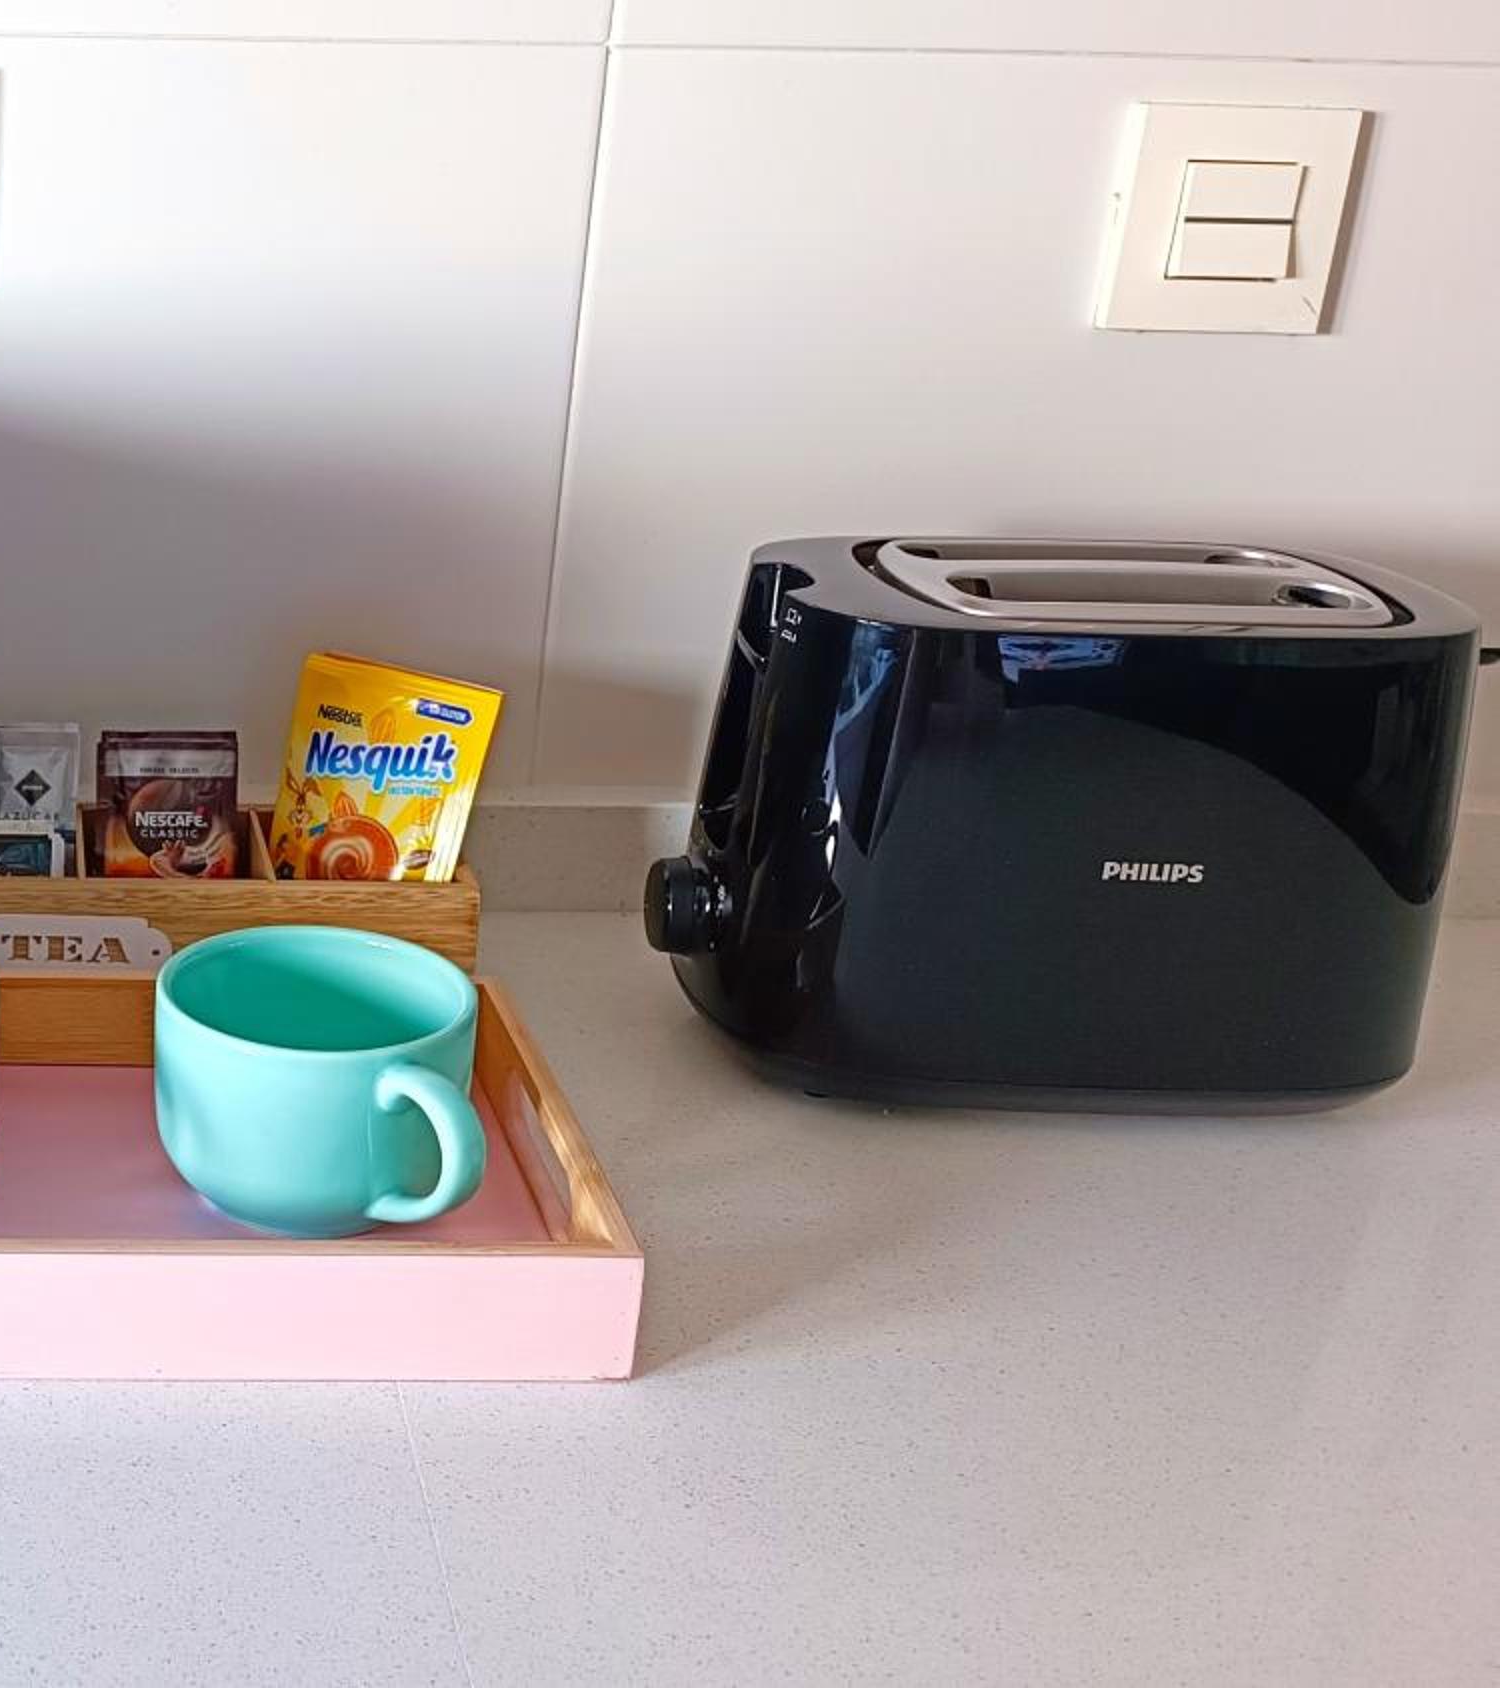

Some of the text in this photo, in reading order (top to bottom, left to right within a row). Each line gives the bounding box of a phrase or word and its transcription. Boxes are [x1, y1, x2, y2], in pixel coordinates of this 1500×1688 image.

[305, 731, 456, 791] Nesquik
[140, 829, 198, 839] CLASSIC
[1101, 861, 1205, 883] PHILIPS
[1, 934, 131, 964] TEA
